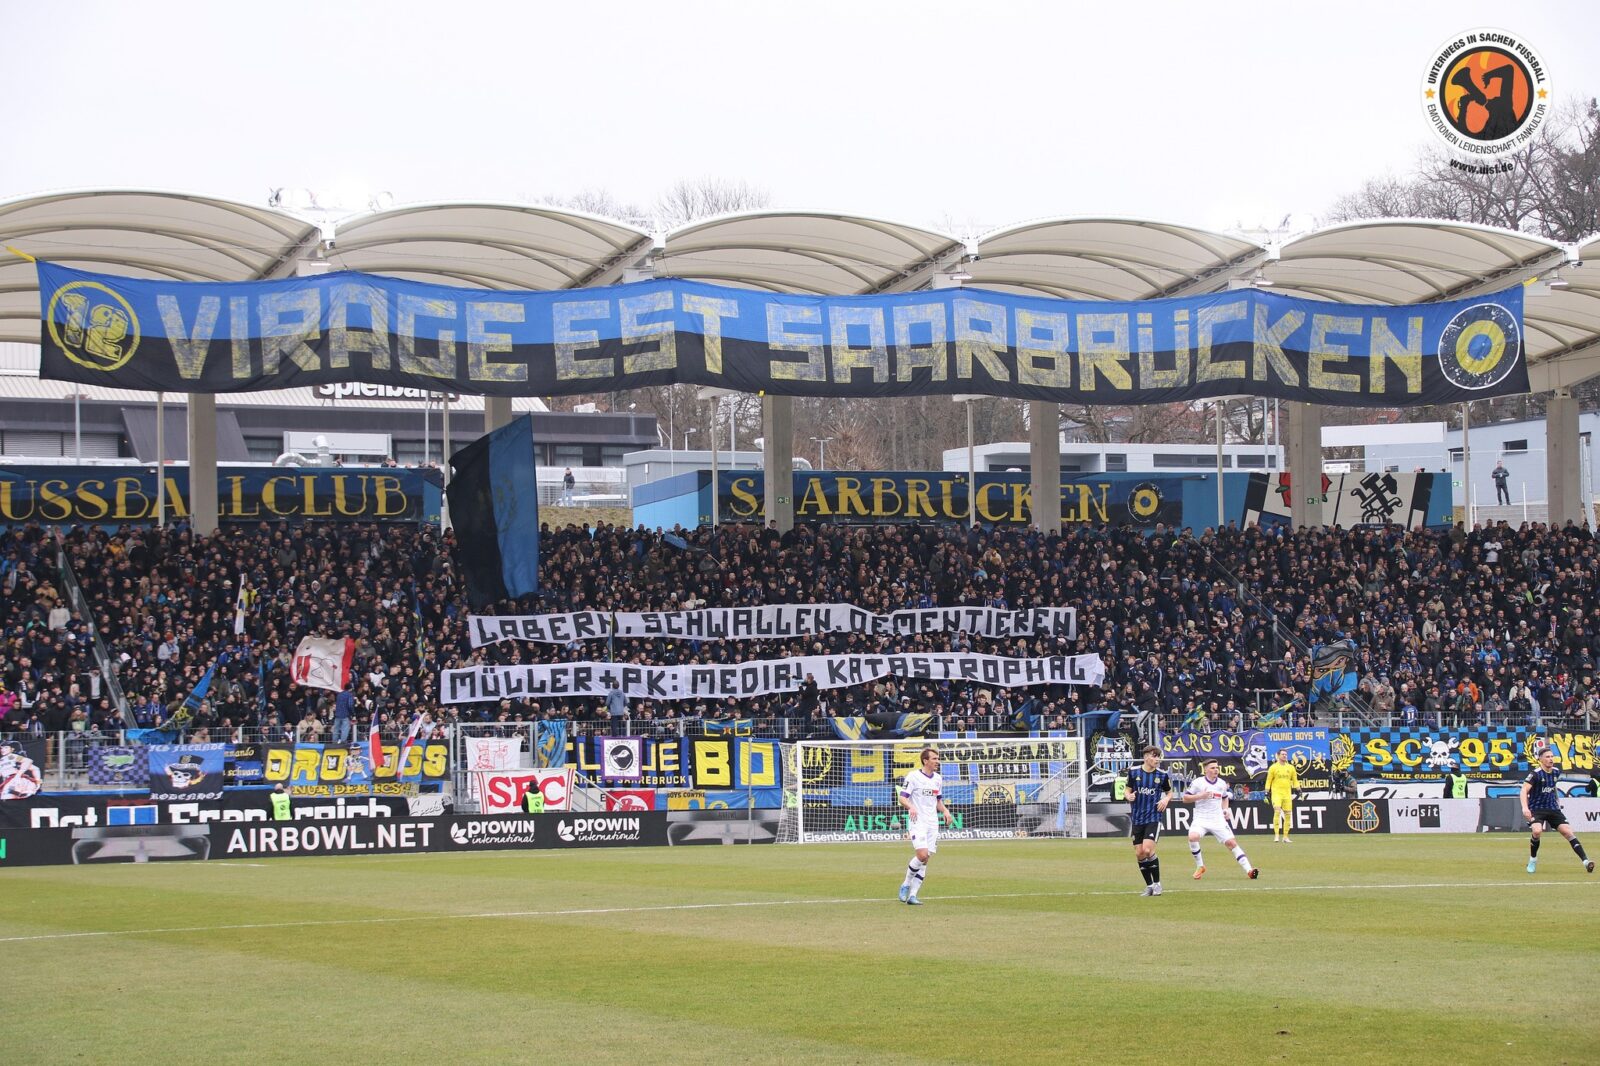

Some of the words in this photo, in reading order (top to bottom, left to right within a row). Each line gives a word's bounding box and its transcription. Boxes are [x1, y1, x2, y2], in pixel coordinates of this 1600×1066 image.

[156, 284, 529, 381] VIRAGE
[553, 291, 740, 379] EST
[766, 298, 1424, 394] SAARBRÜCKEN
[730, 475, 1111, 522] SARBRÜCKEN
[849, 608, 1070, 636] DEMENTIEREN
[827, 656, 1085, 684] KATASTROPHAL
[1163, 732, 1213, 753] SARG
[1218, 733, 1245, 753] 99
[1268, 732, 1293, 741] YOUNG
[1295, 731, 1313, 741] BOYS
[1315, 731, 1325, 740] 99
[1365, 738, 1424, 766] SC
[1458, 738, 1515, 767] 95
[982, 763, 1028, 774] JUGEND
[1198, 762, 1237, 776] TUR
[1381, 772, 1411, 780] VIEILLE
[293, 786, 331, 796] NUR
[1397, 805, 1439, 817] viasit
[227, 823, 435, 853] AIRBOWL.NET
[471, 830, 535, 844] international
[578, 829, 640, 842] international
[804, 831, 859, 842] Eisenbach
[861, 830, 911, 841] Tresore.d
